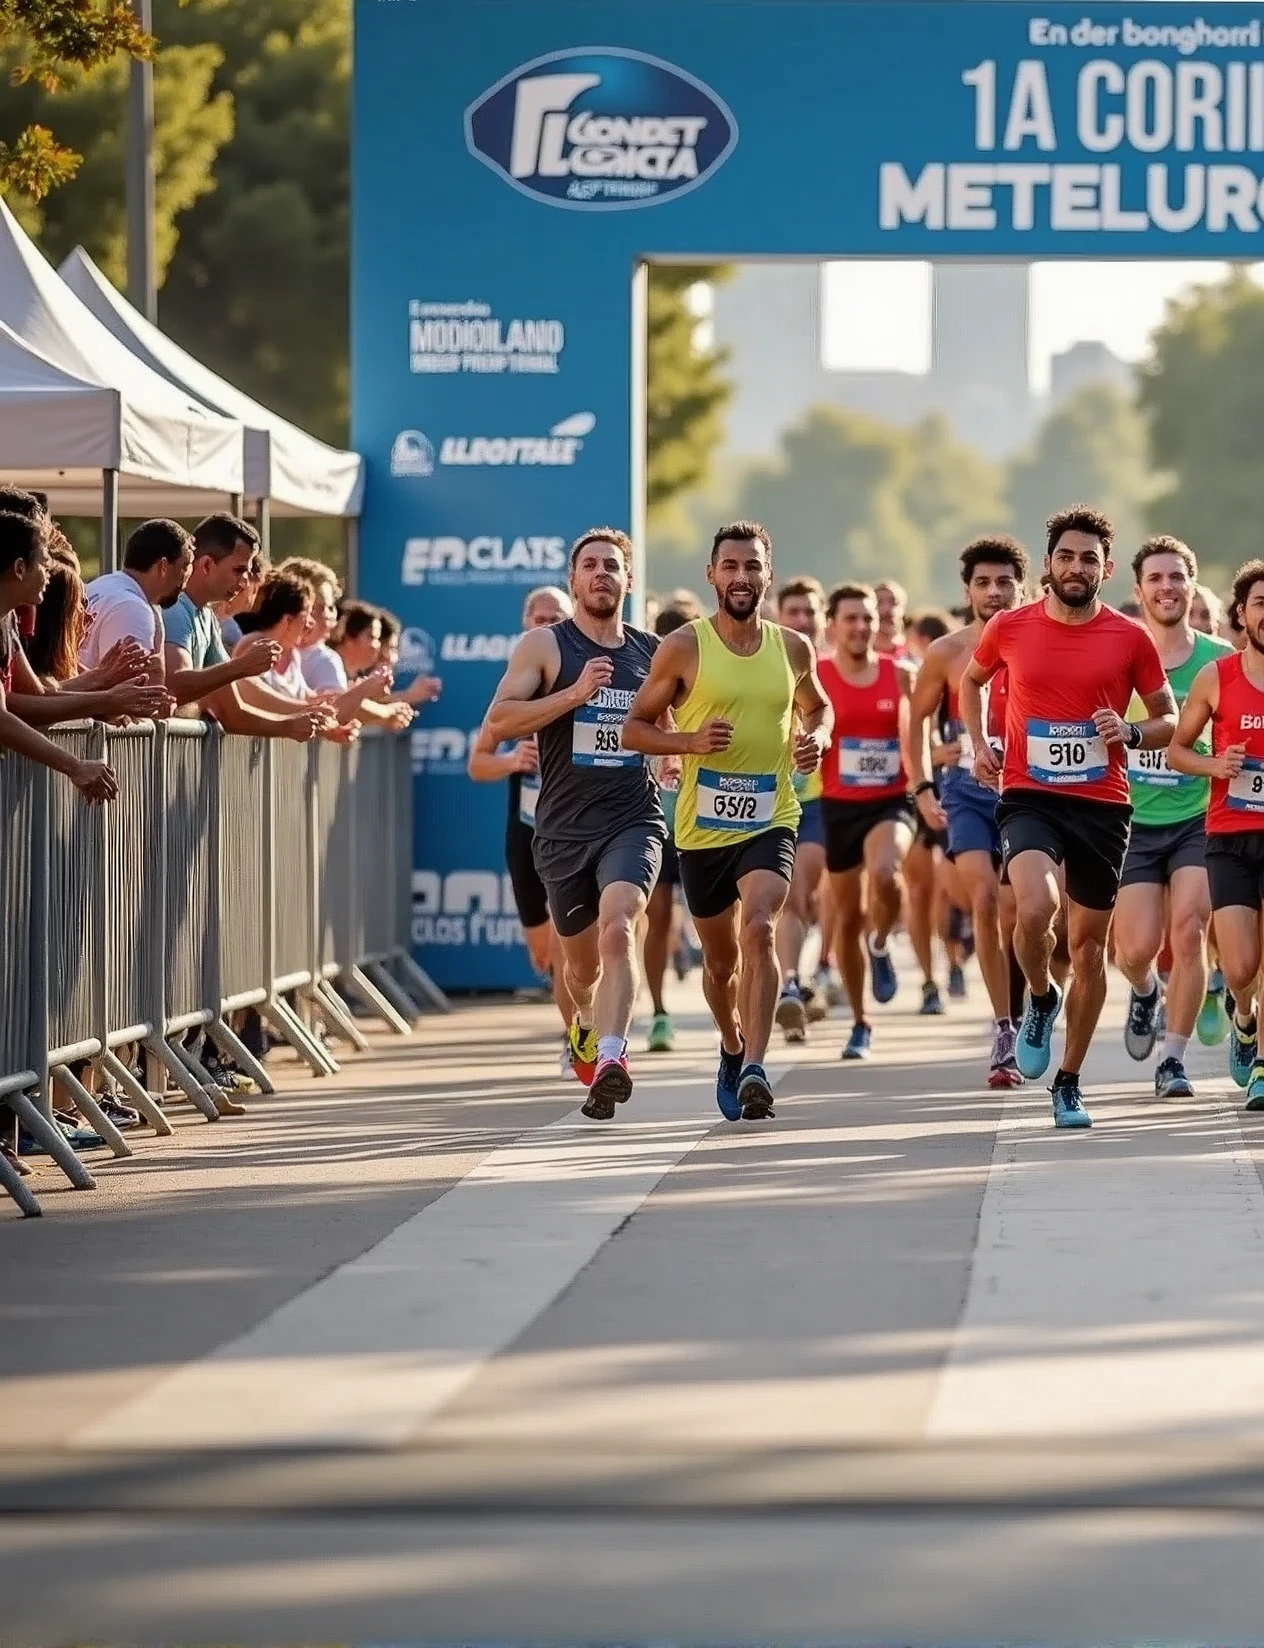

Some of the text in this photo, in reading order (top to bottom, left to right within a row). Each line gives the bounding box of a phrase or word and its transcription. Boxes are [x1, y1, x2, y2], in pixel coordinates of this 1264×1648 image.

[1028, 17, 1068, 47] En
[1070, 17, 1119, 47] der
[961, 59, 1057, 153] 1A
